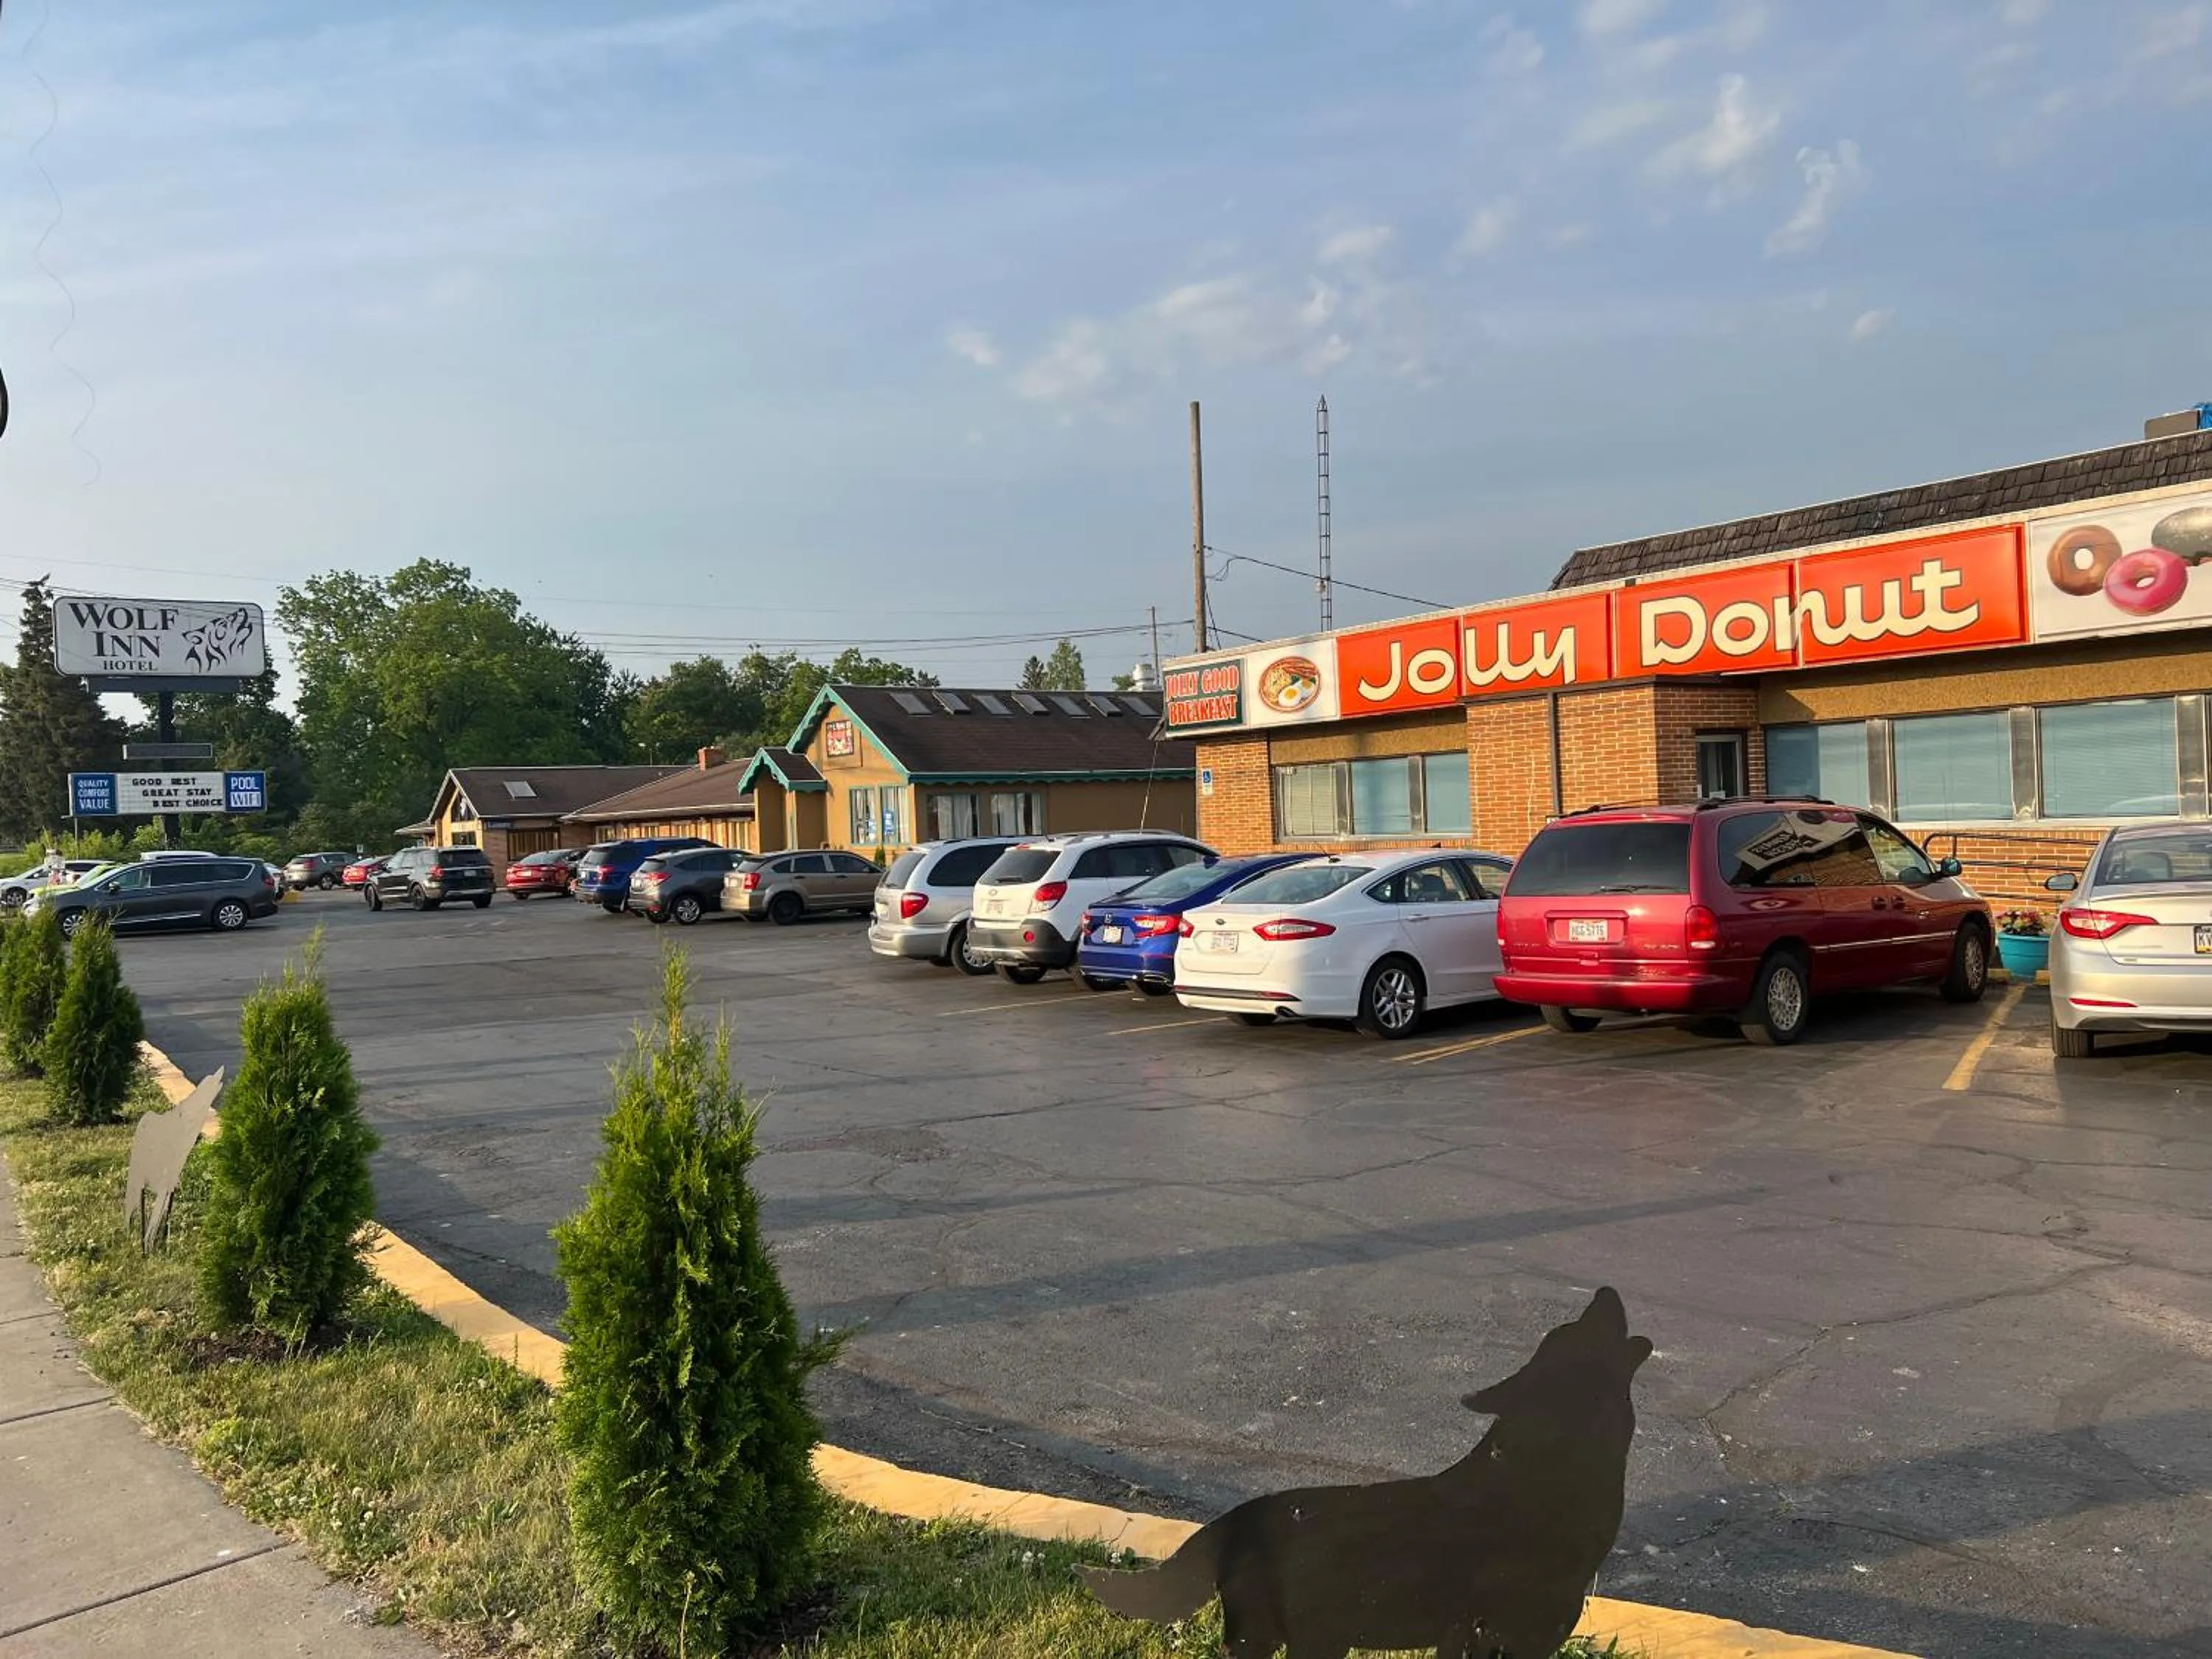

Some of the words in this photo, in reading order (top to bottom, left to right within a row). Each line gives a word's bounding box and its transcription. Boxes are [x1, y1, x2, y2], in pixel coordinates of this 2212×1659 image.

[67, 602, 180, 631] WOLF
[1357, 622, 1576, 702] Jolly
[1640, 557, 1980, 667] Donut
[92, 630, 161, 658] INN
[102, 660, 159, 672] HOTEL
[1165, 671, 1199, 703] JOLLY
[1201, 665, 1239, 694] GOOD
[1168, 693, 1238, 726] BREAKFAST
[77, 779, 109, 788] QUALITY
[132, 778, 162, 786] GOOD
[230, 776, 260, 790] POOL
[77, 788, 110, 798] COMFORT
[142, 788, 179, 797] GREAT
[186, 788, 212, 796] STAY
[79, 799, 111, 809] VALUE
[185, 799, 224, 807] CHOICE
